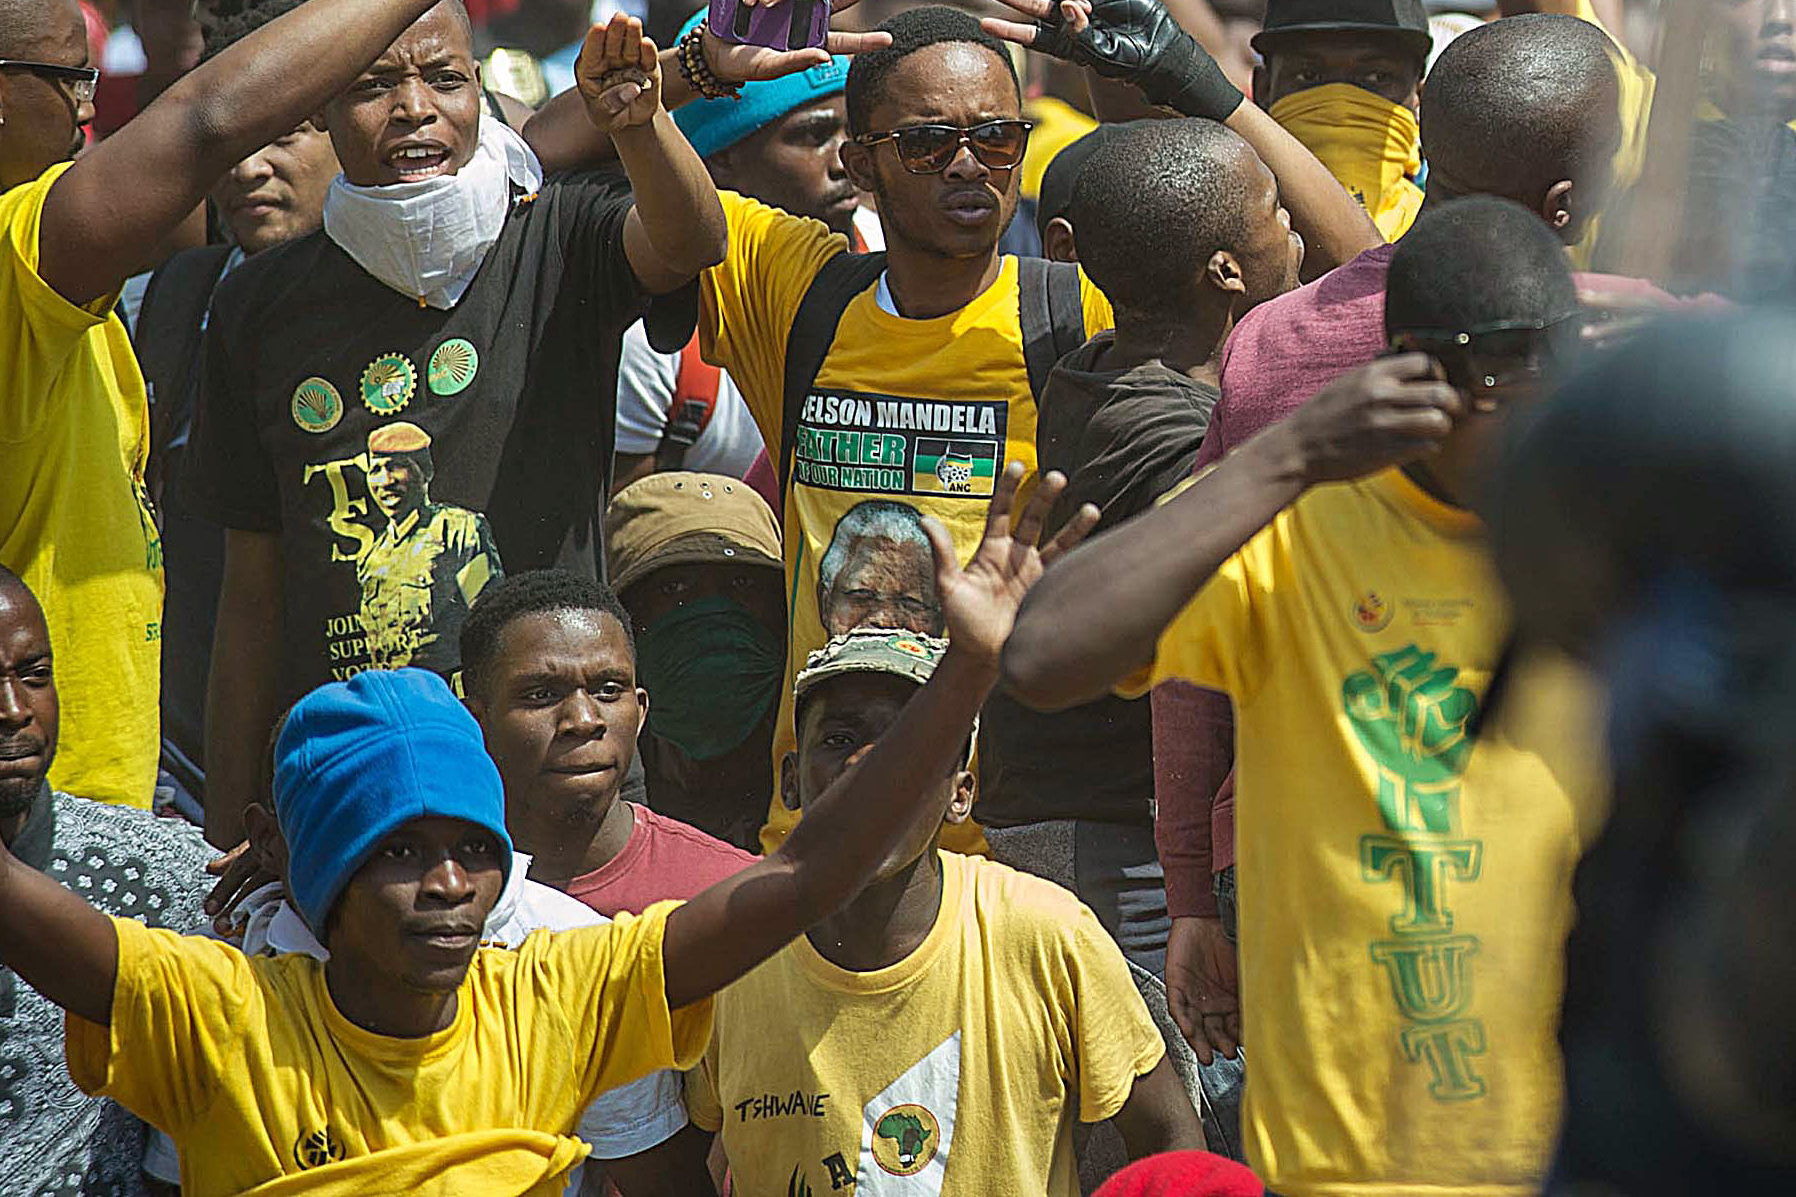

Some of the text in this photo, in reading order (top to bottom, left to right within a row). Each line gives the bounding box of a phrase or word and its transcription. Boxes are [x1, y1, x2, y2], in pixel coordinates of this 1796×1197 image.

[877, 402, 996, 434] MANDELA
[797, 425, 906, 466] FATHER
[811, 464, 838, 487] OUR
[841, 467, 905, 490] NATION
[949, 483, 971, 492] ANC
[735, 1091, 829, 1122] TSHWANE
